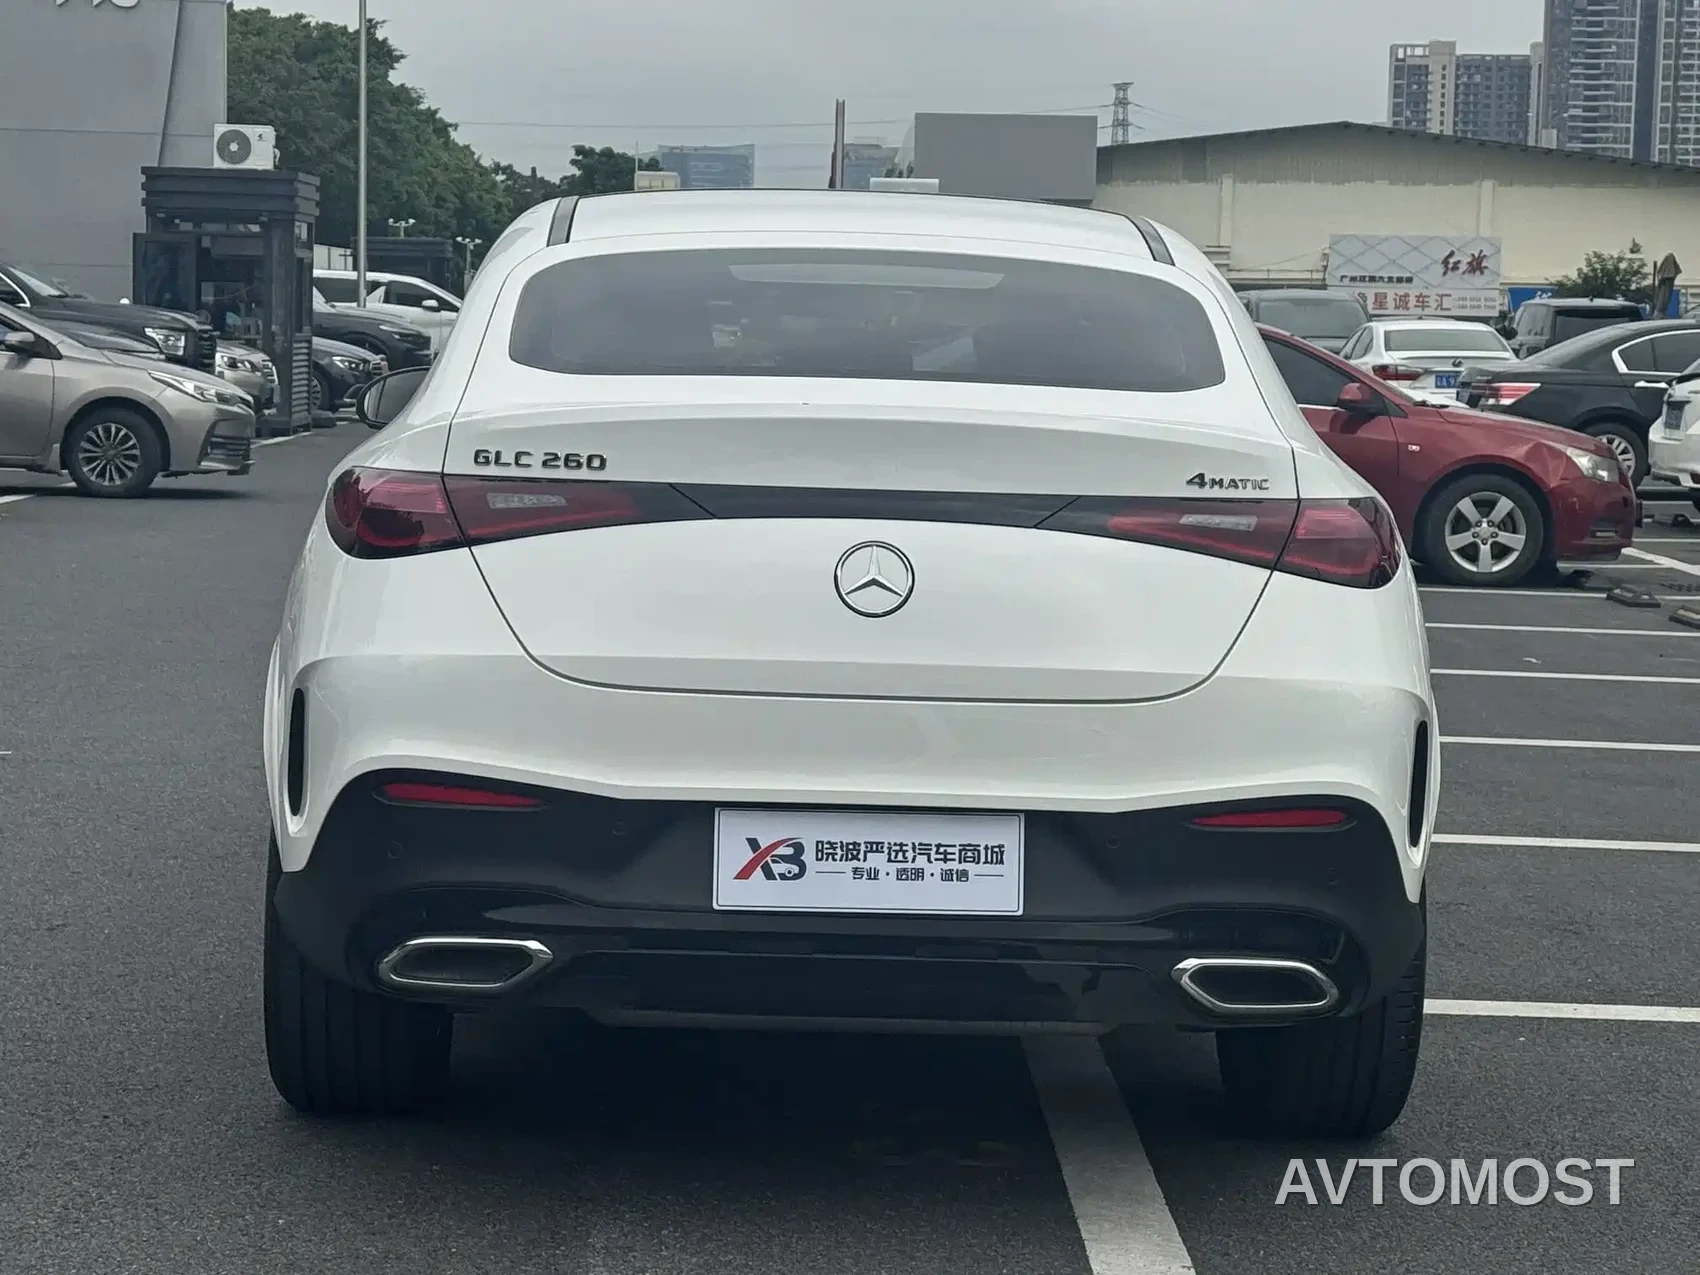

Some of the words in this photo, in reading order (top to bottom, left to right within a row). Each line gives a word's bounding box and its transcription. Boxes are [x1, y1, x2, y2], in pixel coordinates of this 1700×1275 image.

[1441, 249, 1489, 276] 红旗
[473, 449, 534, 468] GLC
[541, 452, 607, 471] 260
[1186, 472, 1270, 490] 4MATIC
[815, 840, 1005, 866] 晓波严选汽车商城
